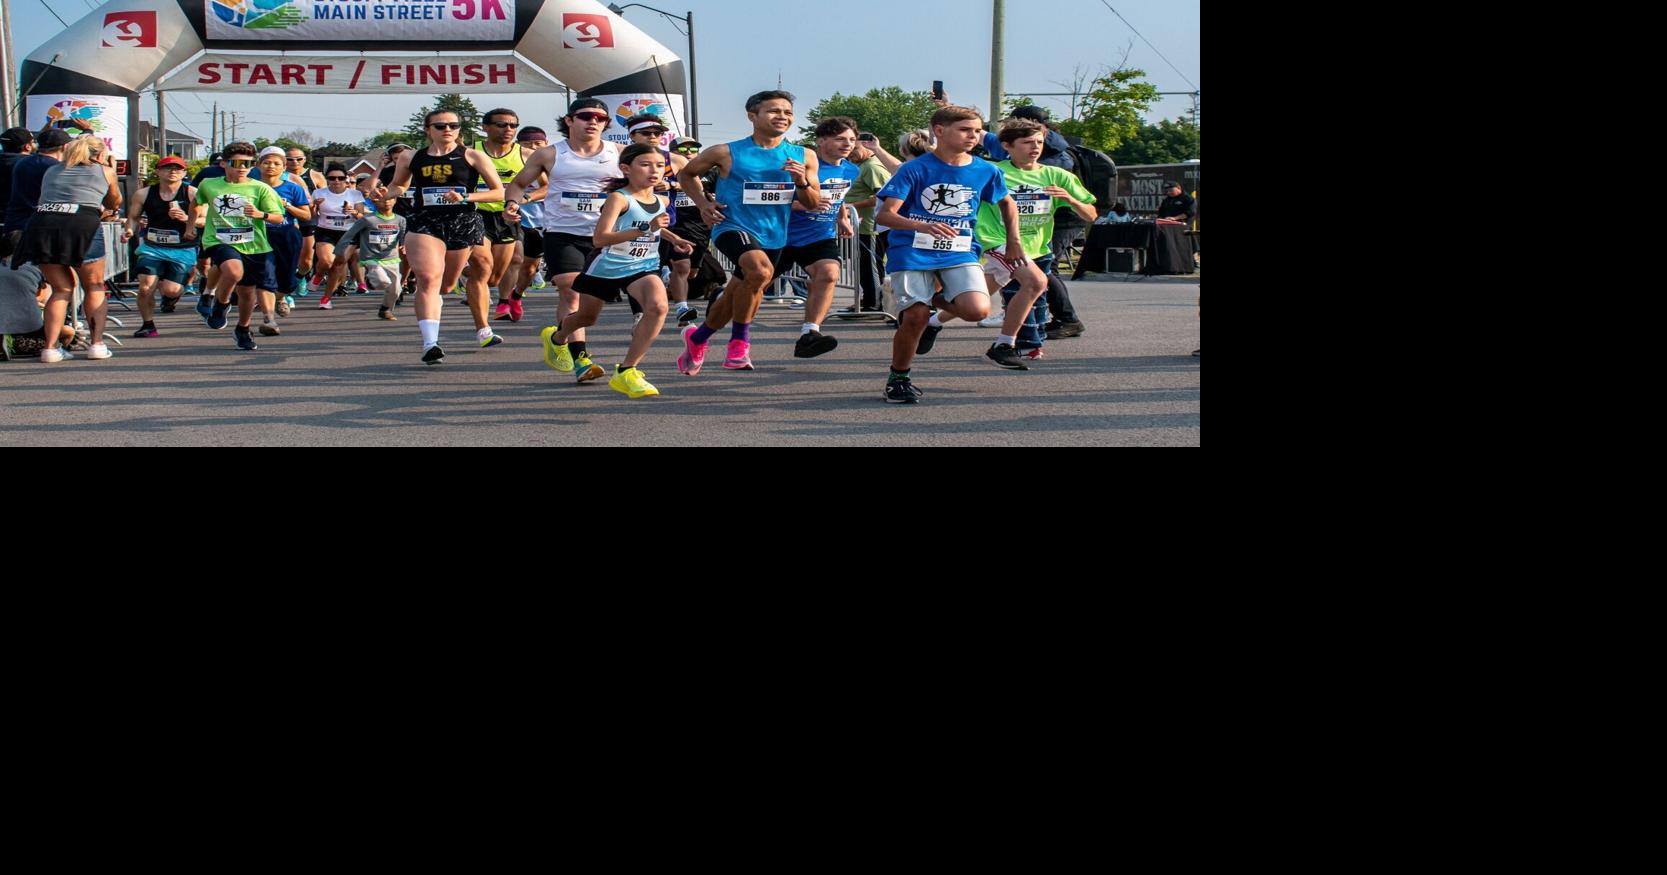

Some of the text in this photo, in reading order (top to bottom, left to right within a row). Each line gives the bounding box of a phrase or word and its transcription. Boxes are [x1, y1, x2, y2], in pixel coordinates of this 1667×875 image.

[314, 5, 446, 20] MAIN STREET
[198, 60, 516, 89] START / FINISH
[421, 164, 453, 177] USS
[1131, 179, 1164, 195] MOST
[761, 192, 780, 201] 886
[577, 203, 592, 211] 571
[932, 239, 953, 250] 555
[629, 247, 649, 257] 487
